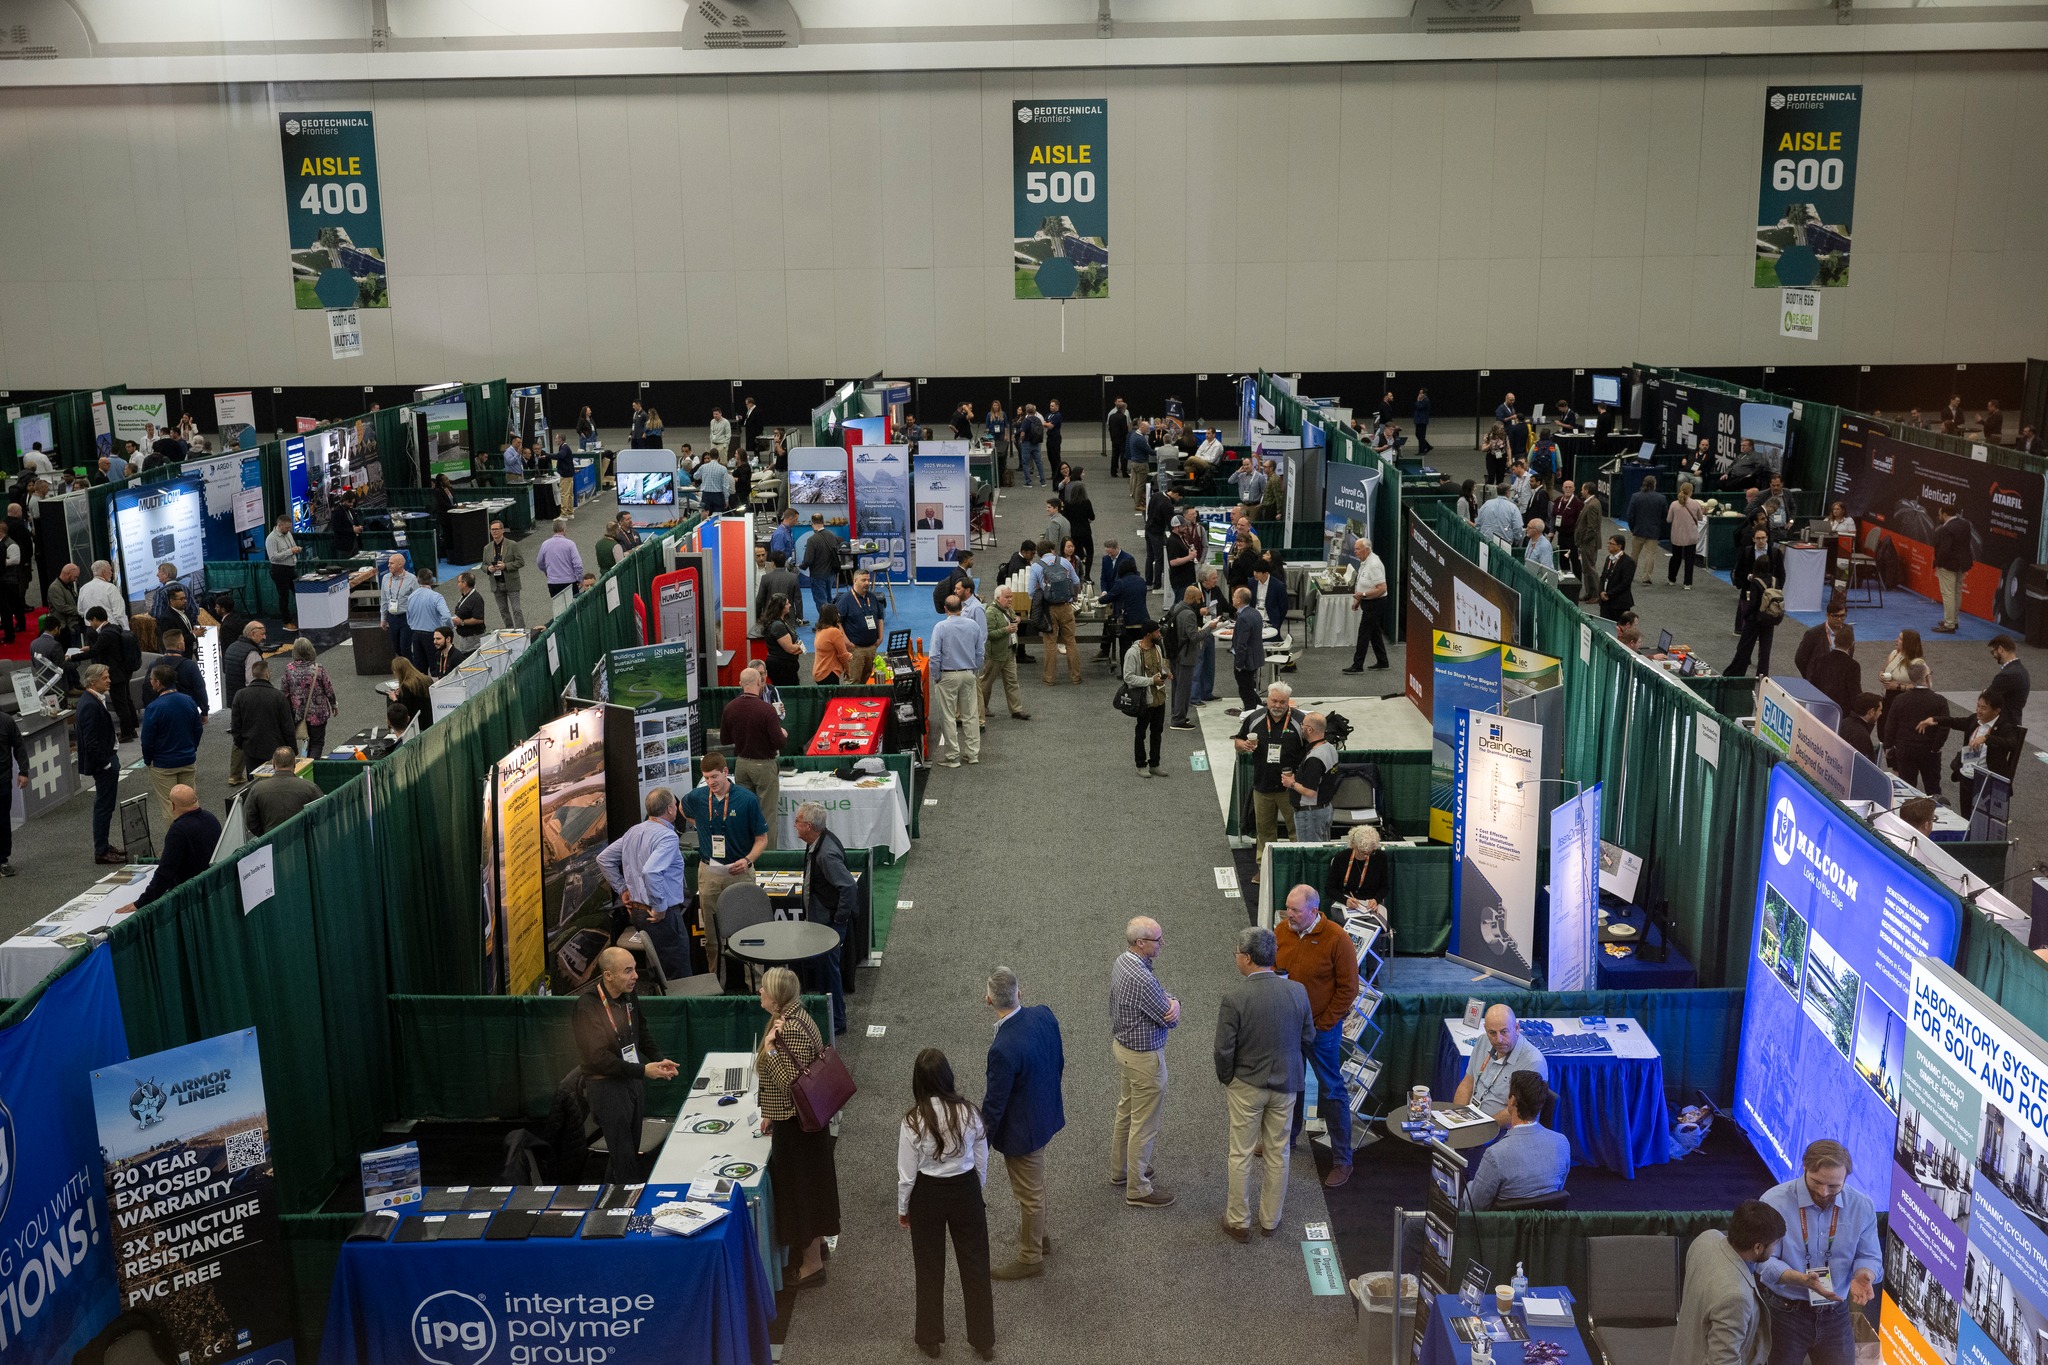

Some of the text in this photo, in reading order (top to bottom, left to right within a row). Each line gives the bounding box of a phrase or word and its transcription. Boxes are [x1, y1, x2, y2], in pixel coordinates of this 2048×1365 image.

[1786, 92, 1857, 102] GEOTECHNICAL
[1786, 101, 1824, 110] Frontiers
[301, 118, 369, 128] GEOTECHNICAL
[1033, 106, 1102, 116] GEOTECHNICAL
[1034, 114, 1071, 124] Frontiers
[301, 126, 338, 136] Frontiers
[1778, 132, 1842, 152] AISLE
[1029, 144, 1090, 164] AISLE
[300, 157, 361, 176] AISLE
[1772, 158, 1844, 191] 600
[300, 183, 368, 215] 400
[1026, 171, 1095, 204] 500
[1786, 292, 1814, 306] BOOTH 616
[332, 314, 347, 327] BOOTH
[1791, 313, 1812, 326] RE-GEN
[334, 332, 360, 348] MULTIFLOW
[116, 404, 156, 412] GeoCAAB
[1718, 412, 1734, 436] BIO
[138, 491, 180, 512] MULTIFLOW
[1334, 496, 1344, 508] Let
[1341, 486, 1356, 497] Unroll
[1922, 484, 1956, 505] Identical?
[1992, 492, 2022, 510] ATARFIL
[662, 590, 692, 604] HUMBOLDT
[614, 653, 635, 661] Building
[664, 646, 684, 656] Naue
[1452, 642, 1462, 652] iec
[212, 643, 220, 696] HUESKER
[614, 658, 646, 668] sustainable
[1518, 658, 1528, 668] iec
[1435, 667, 1447, 675] Need
[1454, 670, 1466, 679] Store
[1467, 674, 1478, 683] Your
[1479, 678, 1498, 687] Biogas?
[1489, 686, 1498, 694] You!
[640, 708, 656, 716] range
[1762, 699, 1792, 743] GALE
[569, 722, 578, 740] H
[1458, 718, 1466, 774] WALLS
[1478, 736, 1531, 758] DrainGreat
[1798, 728, 1825, 759] Sustainable
[1825, 750, 1843, 775] Textiles
[502, 743, 538, 782] HALLATON
[1795, 744, 1817, 770] Designed
[1824, 770, 1845, 795] Extreme
[792, 799, 851, 812] Nue
[1479, 839, 1495, 848] Reliable
[1496, 844, 1521, 855] Connection
[1489, 830, 1508, 840] Effective
[1489, 836, 1514, 847] Installation
[1796, 830, 1859, 902] MALCOLM
[1804, 864, 1844, 911] Look to the Blue
[1884, 896, 1922, 932] SONIC EXPLORATIONS
[1886, 886, 1930, 924] DEWATERING SOLUTIONS
[1879, 930, 1893, 946] DESIGN
[1881, 919, 1904, 943] GEOTHERMAL
[1882, 908, 1930, 951] ENVIRONMENTAL DRILLING
[1877, 946, 1894, 966] Innovators
[1882, 965, 1903, 989] Geotechnical
[1915, 976, 2001, 1057] LABORATORY
[1913, 1000, 2014, 1105] FOR SOIL AND
[170, 1068, 232, 1096] ARMOR
[1916, 1050, 1965, 1103] DYNAMIC (CYCLIC)
[177, 1082, 226, 1106] LINER
[1918, 1068, 1959, 1112] SIMPLE SHEAR
[1925, 1099, 1968, 1146] and Infrastructure Projects
[114, 1150, 198, 1190] 20 YEAR
[396, 1156, 418, 1165] SOLUTIONS
[114, 1165, 211, 1210] EXPOSED
[14, 1164, 91, 1256] YOU WITH
[117, 1178, 234, 1230] WARRANTY
[122, 1199, 260, 1258] 3X PUNCTURE
[1901, 1188, 1955, 1254] RESONANT COLUMN
[1975, 1191, 2032, 1256] DYNAMIC (CYCLIC)
[124, 1223, 244, 1280] RESISTANCE
[1909, 1222, 1943, 1264] Infrastructure Projects
[1931, 1238, 1950, 1264] Earthquake
[1950, 1260, 1958, 1271] and
[1979, 1223, 2035, 1284] Frozen Soils and Infrastructure
[1998, 1232, 2015, 1254] Offshore,
[2015, 1249, 2039, 1278] Earthquake,
[128, 1262, 222, 1308] PVC FREE
[504, 1292, 655, 1319] intertape
[237, 1331, 249, 1341] NSF
[419, 1316, 486, 1350] ipg
[508, 1316, 644, 1343] polymer
